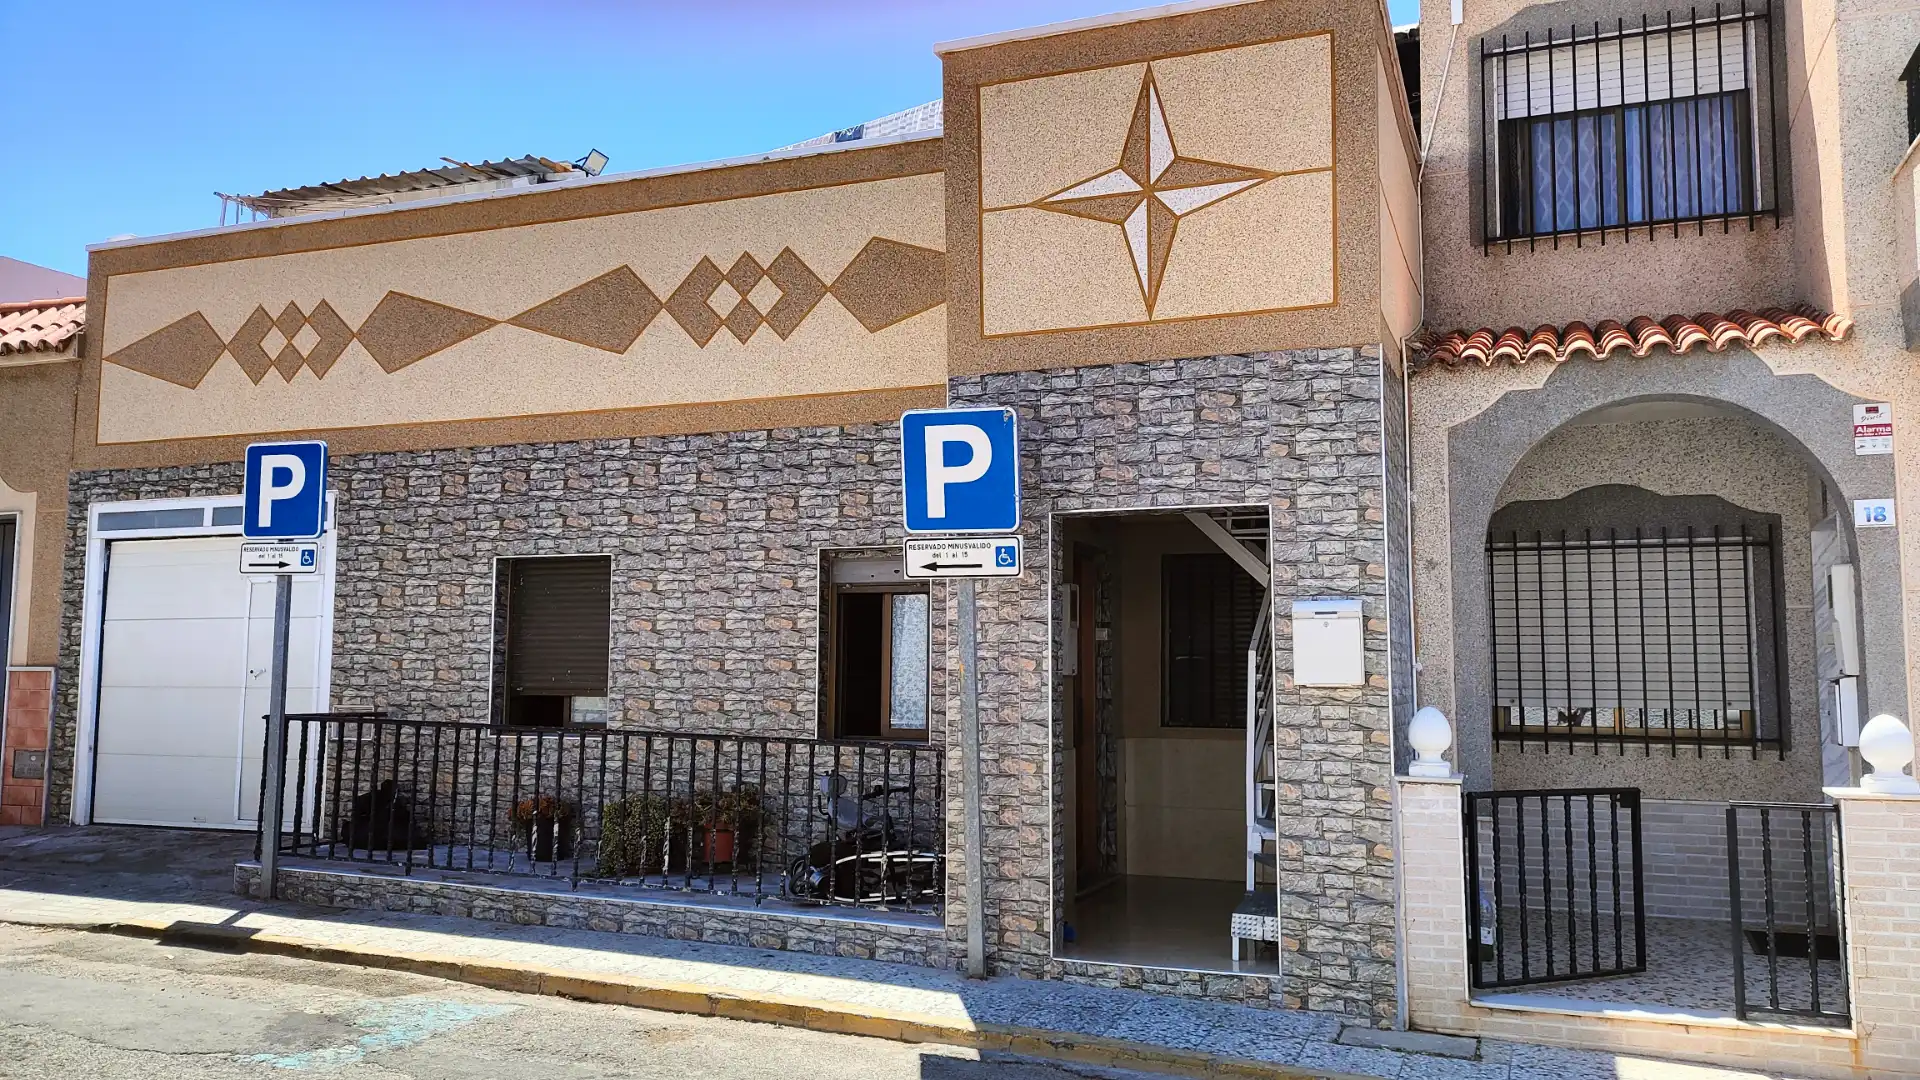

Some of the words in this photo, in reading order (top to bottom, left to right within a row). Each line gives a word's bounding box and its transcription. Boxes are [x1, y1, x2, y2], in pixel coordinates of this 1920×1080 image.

[1856, 425, 1892, 433] Alarma
[923, 424, 993, 519] P
[258, 454, 306, 527] P
[1863, 506, 1887, 522] 18
[947, 542, 992, 550] MINUSVALIDO
